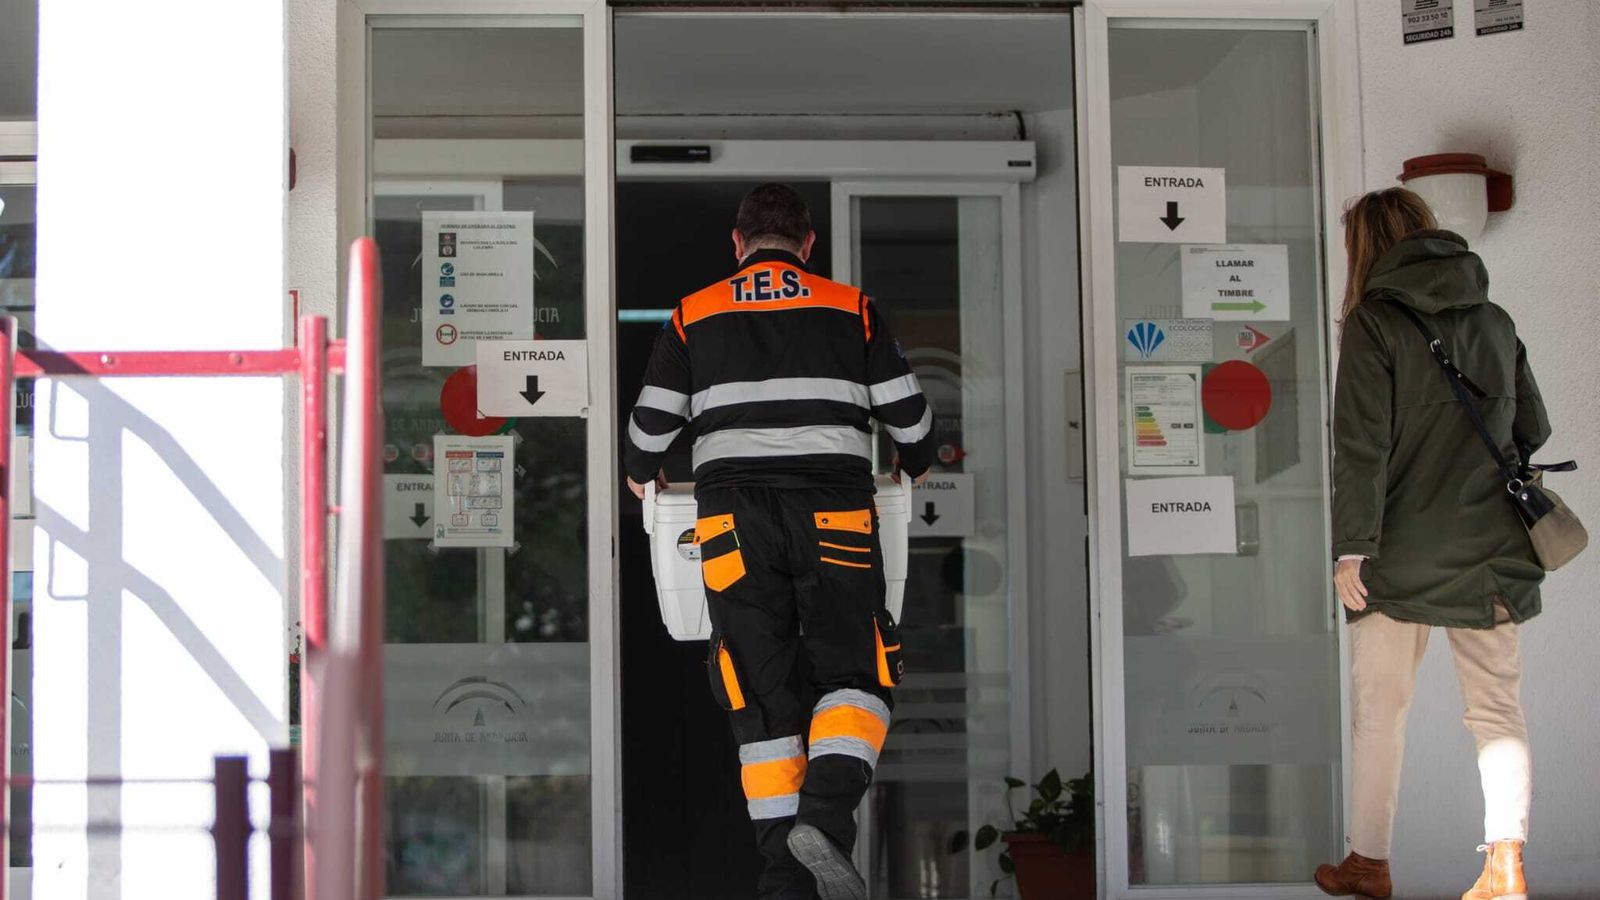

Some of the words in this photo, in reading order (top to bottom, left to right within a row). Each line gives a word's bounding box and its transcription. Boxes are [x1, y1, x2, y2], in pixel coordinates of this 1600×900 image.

[1405, 30, 1439, 42] SEGURIDAD
[1144, 176, 1204, 188] ENTRADA
[1215, 259, 1254, 268] LLAMAR
[1229, 274, 1242, 283] AL
[729, 267, 811, 303] T.E.S.
[1218, 289, 1254, 297] TIMBRE
[503, 350, 566, 361] ENTRADA
[396, 482, 434, 492] ENTRA
[1151, 501, 1212, 513] ENTRADA
